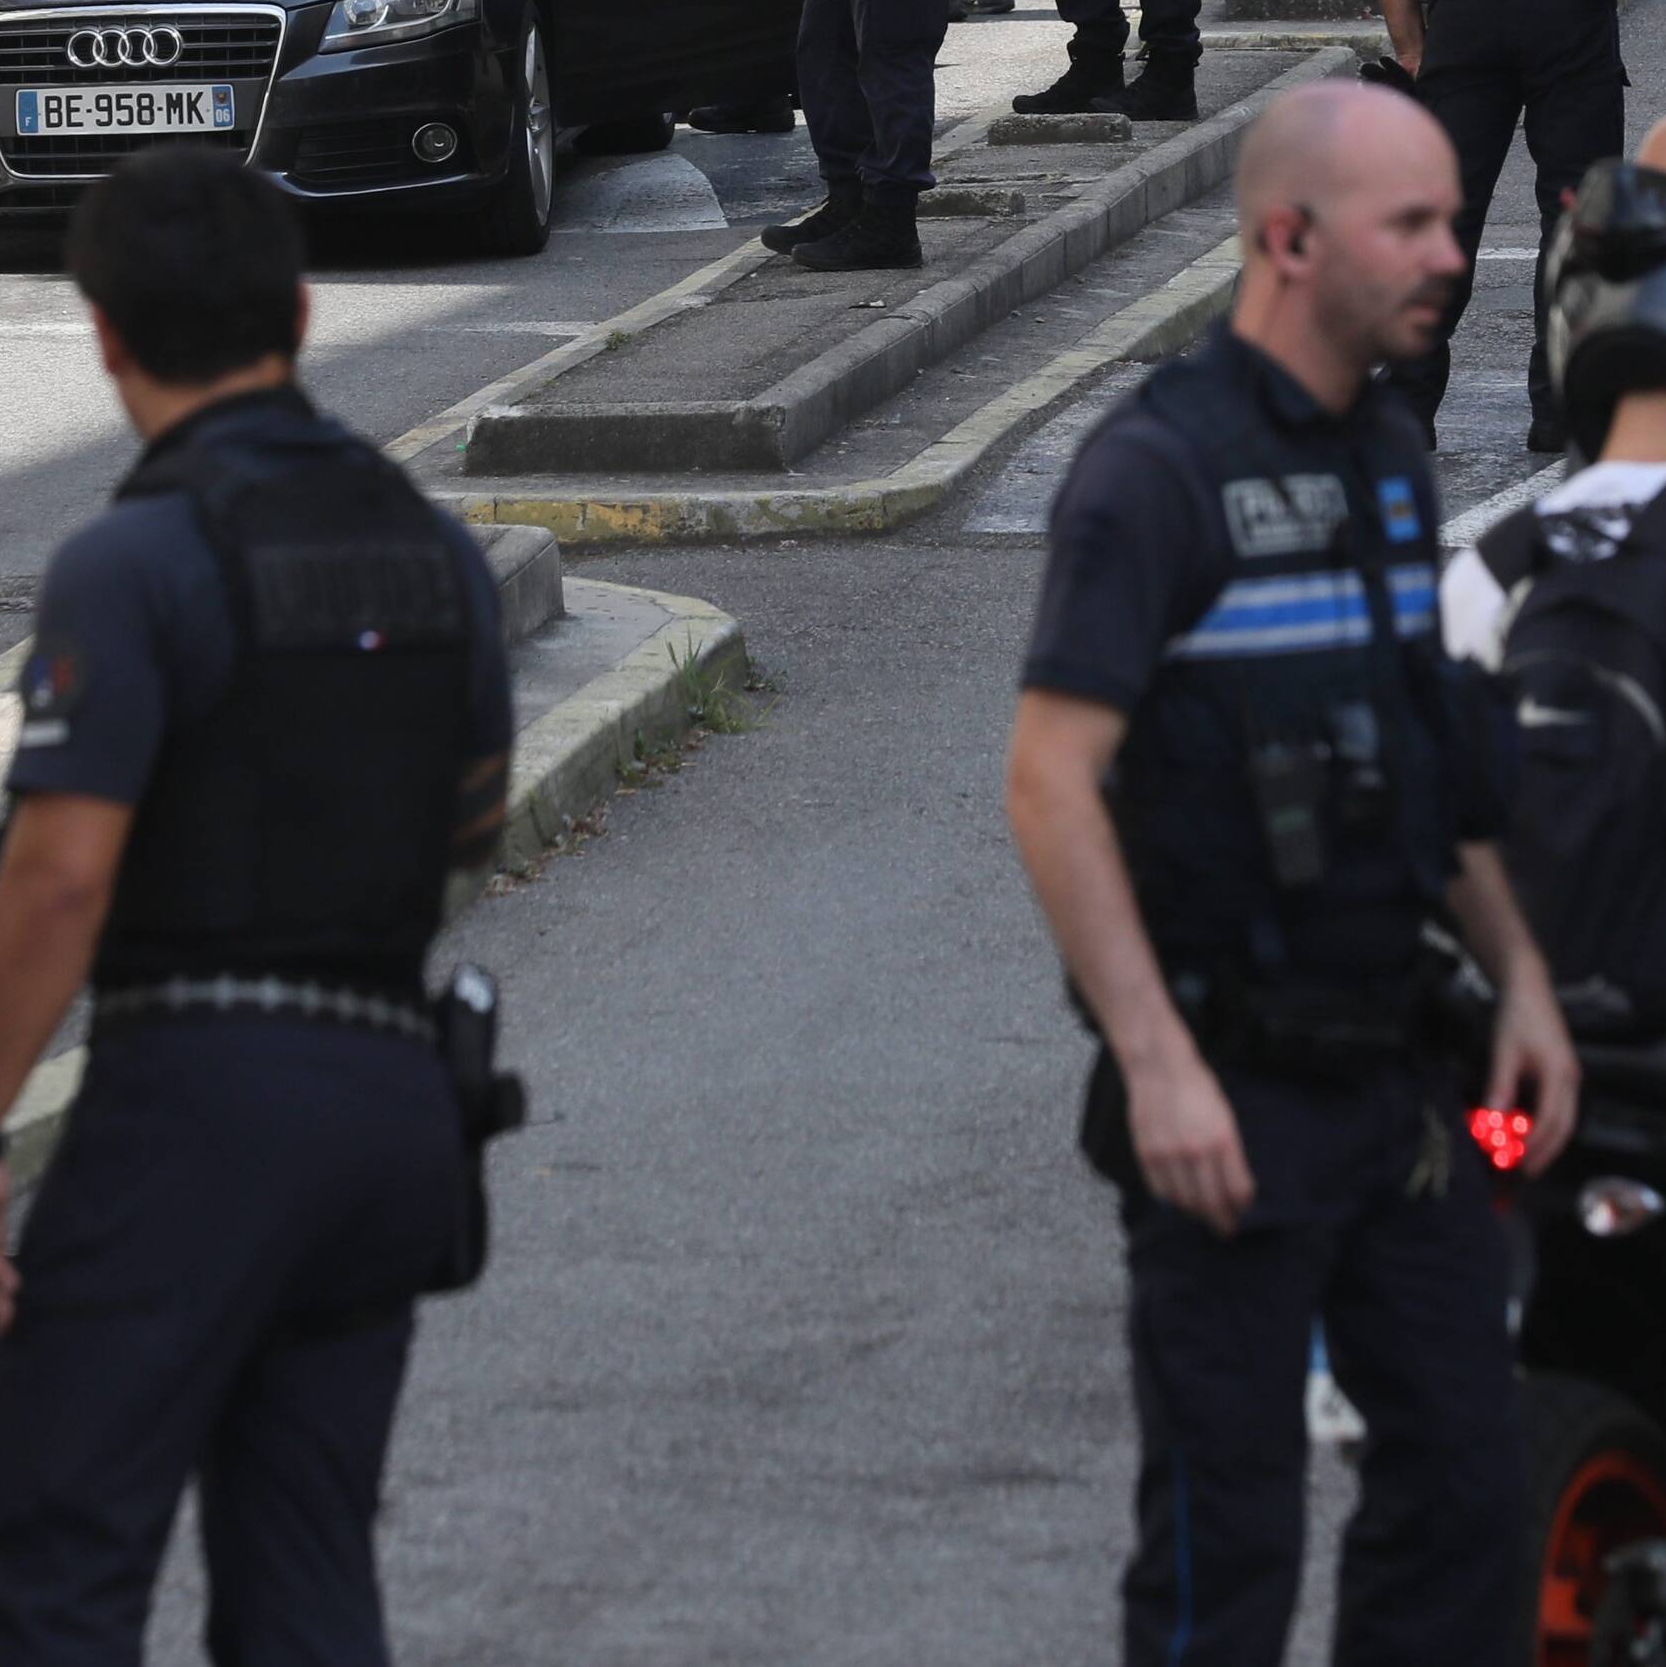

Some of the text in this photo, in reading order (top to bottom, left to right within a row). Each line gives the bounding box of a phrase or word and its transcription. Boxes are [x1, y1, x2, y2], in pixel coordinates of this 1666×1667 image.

[44, 91, 205, 128] BE-958-MK
[215, 108, 231, 123] 06
[25, 117, 32, 127] F
